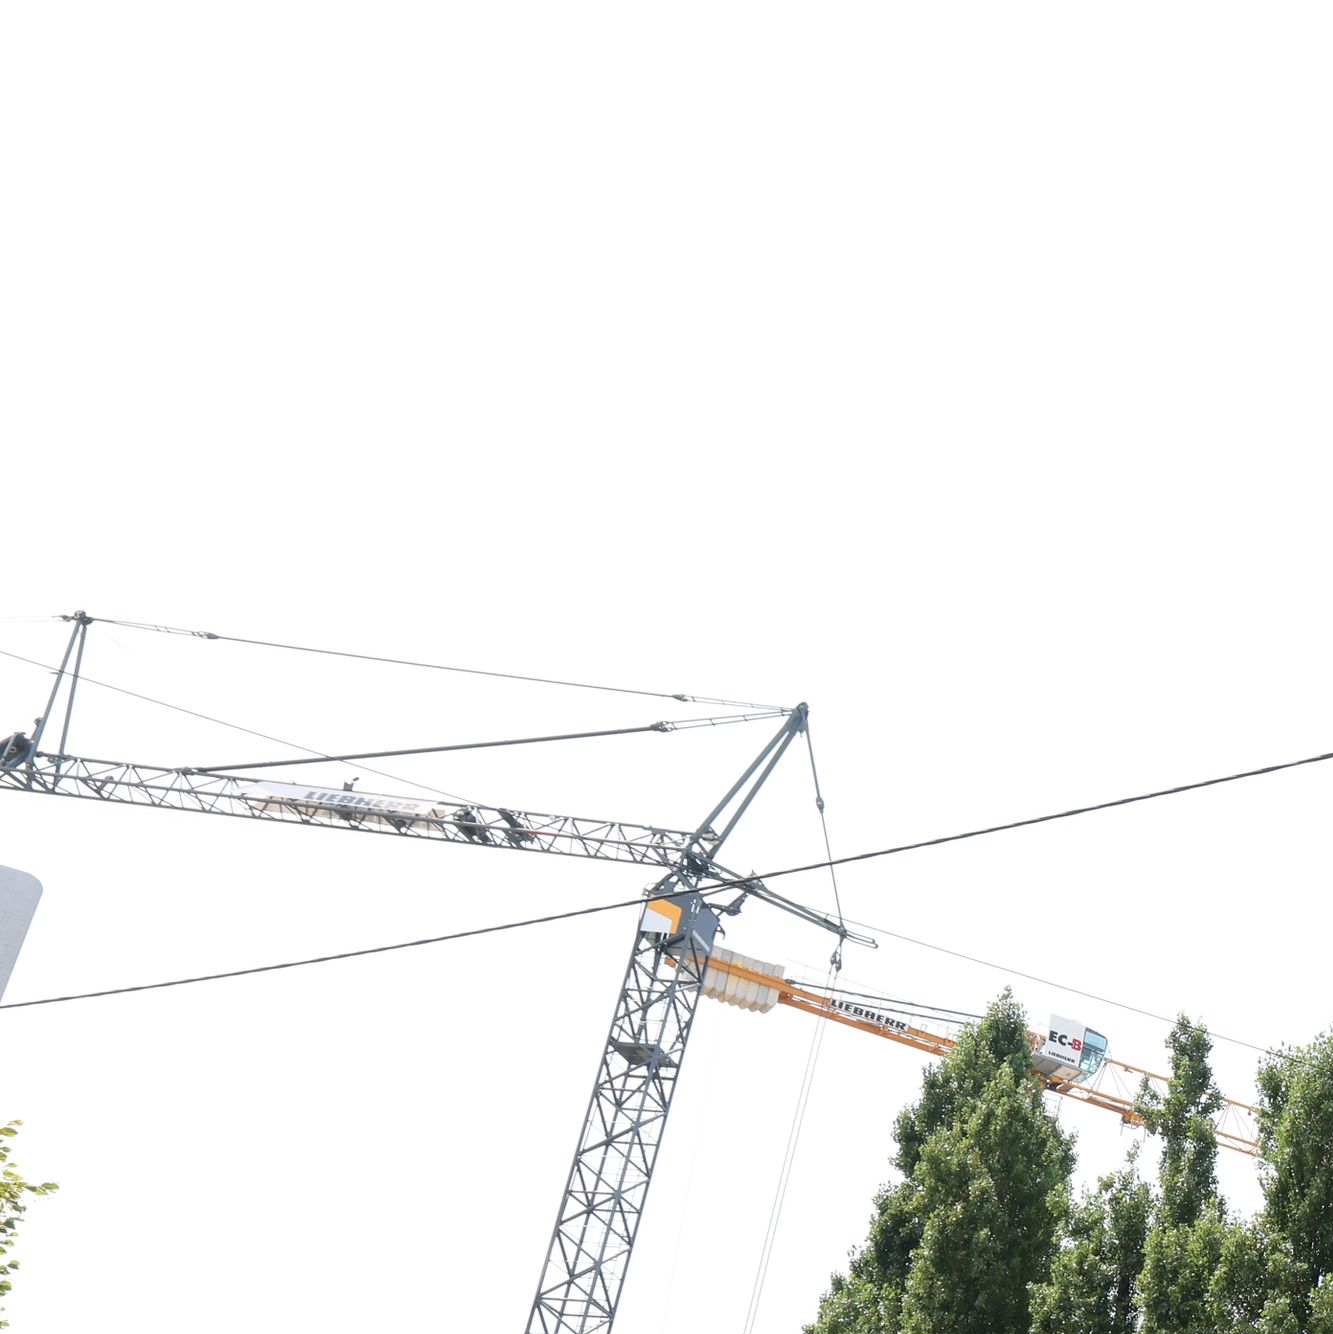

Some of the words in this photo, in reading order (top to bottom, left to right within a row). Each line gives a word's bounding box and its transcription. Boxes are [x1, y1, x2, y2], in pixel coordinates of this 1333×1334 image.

[304, 791, 420, 810] LIEBHERR
[831, 999, 907, 1030] LIEBHERR
[1049, 1030, 1082, 1051] EC-B
